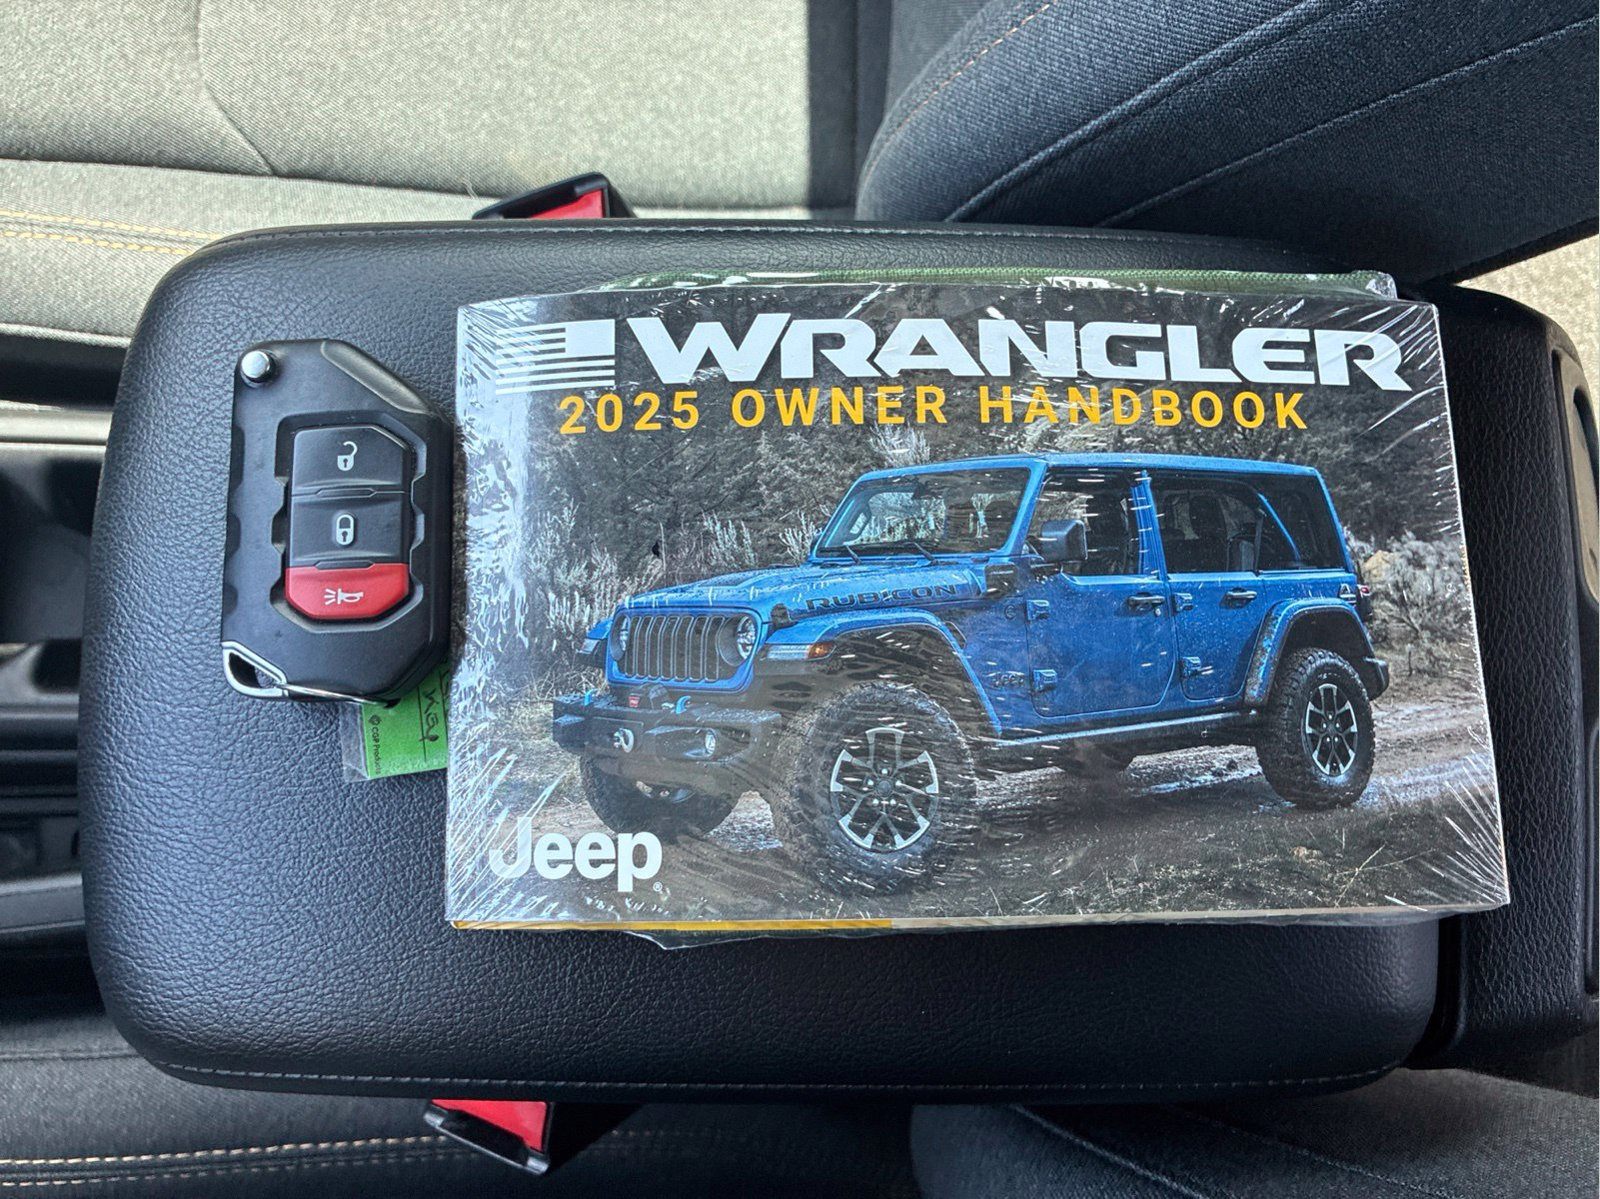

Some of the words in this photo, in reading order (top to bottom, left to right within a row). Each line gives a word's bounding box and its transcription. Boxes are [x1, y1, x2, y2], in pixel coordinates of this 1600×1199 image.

[626, 313, 1412, 391] WRANGLER
[559, 390, 699, 434] 2025
[731, 385, 947, 427] OWNER
[979, 385, 1307, 429] HANDBOOK
[806, 584, 957, 611] RUBICON
[371, 726, 380, 744] CGP
[489, 817, 662, 892] Jeep
